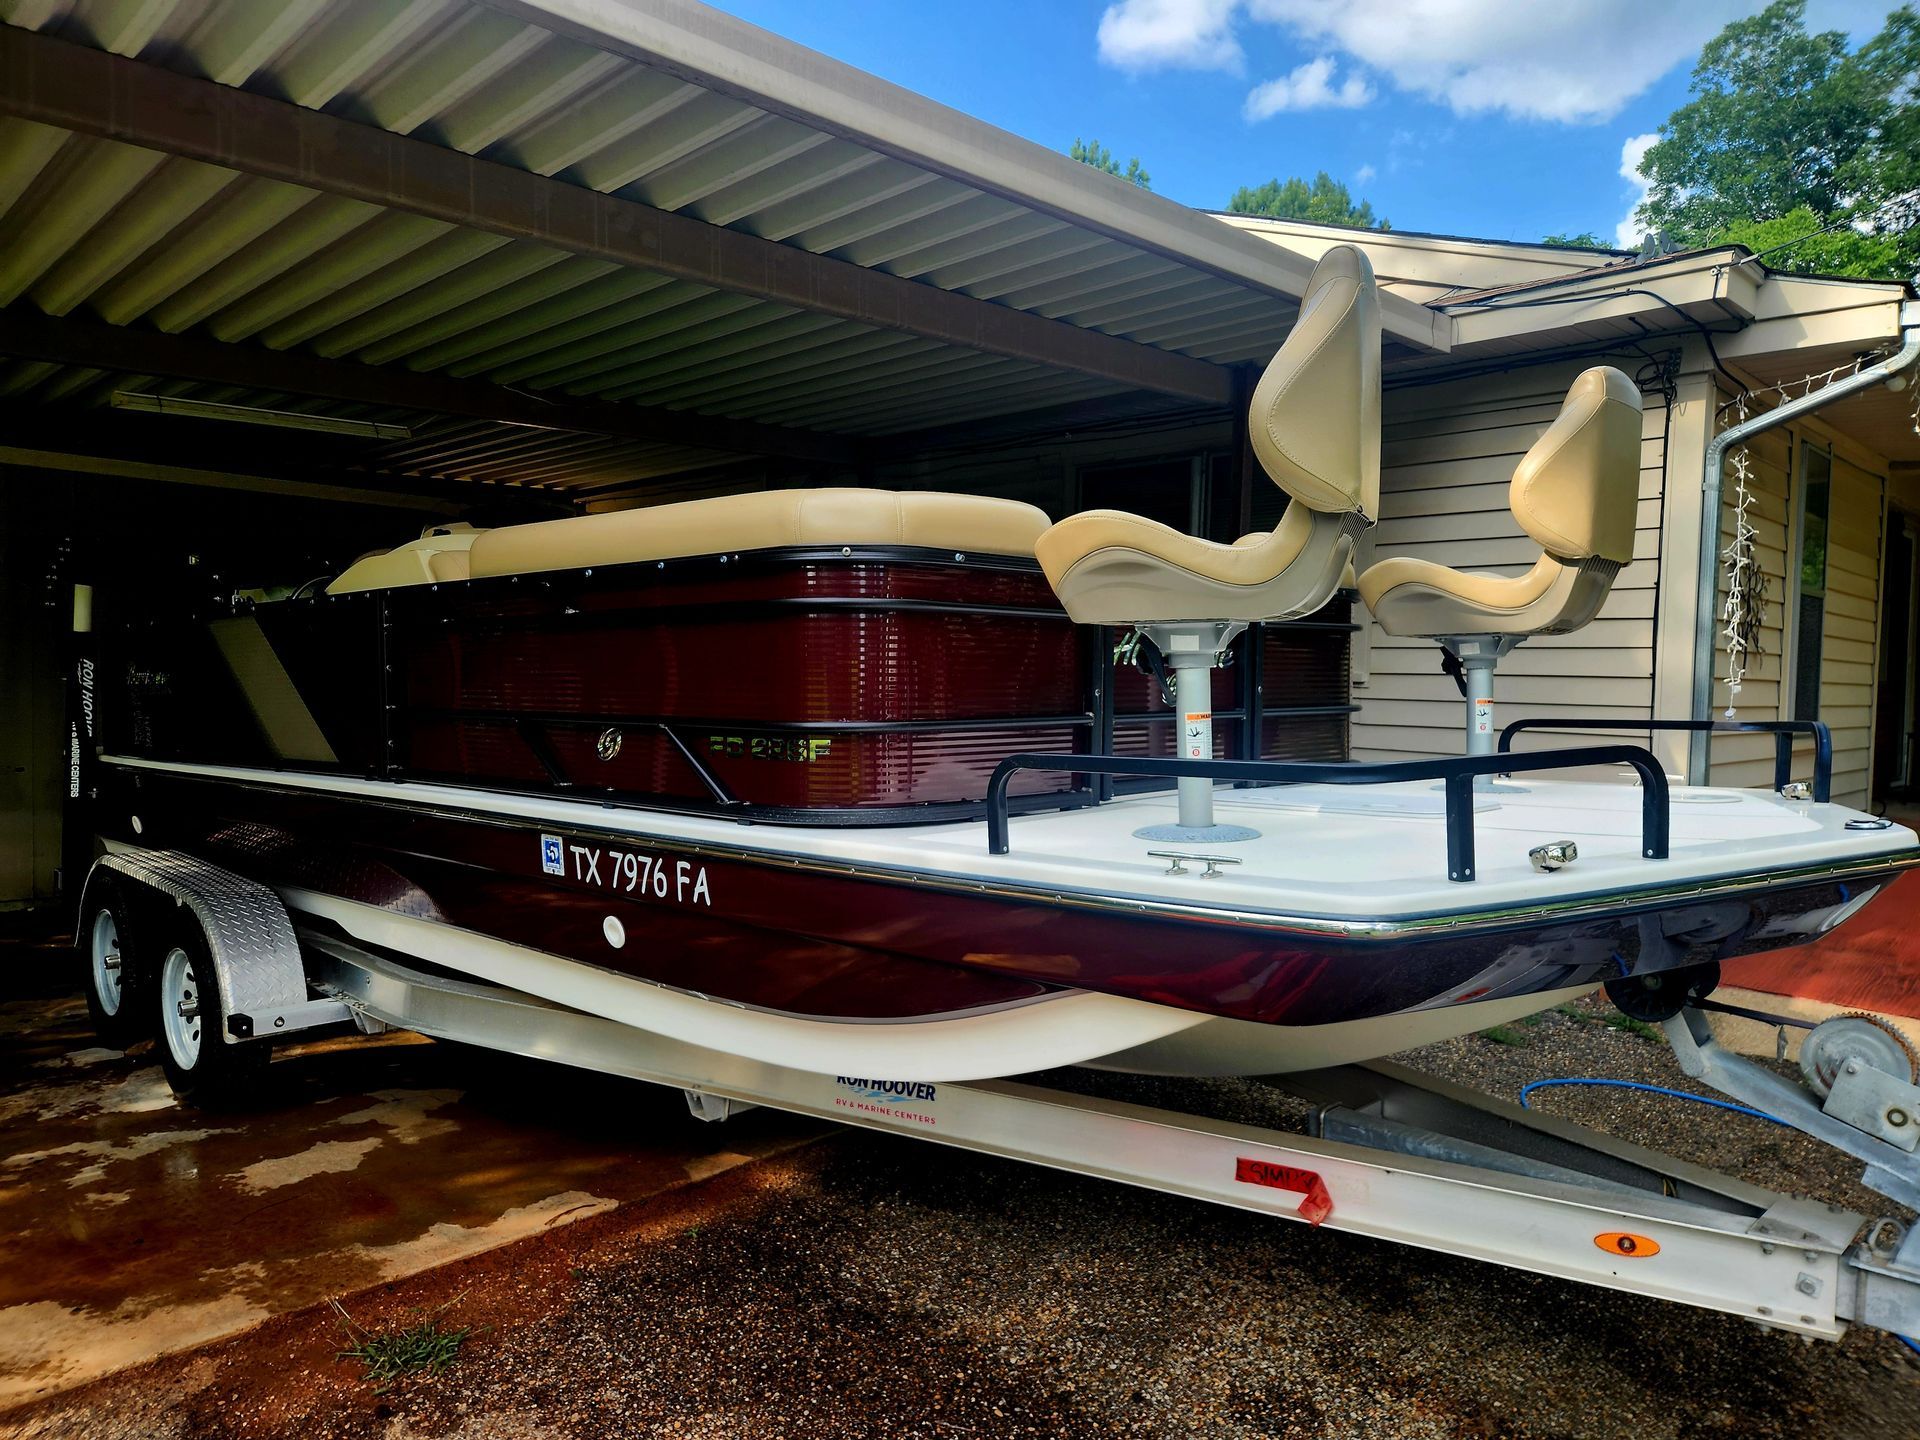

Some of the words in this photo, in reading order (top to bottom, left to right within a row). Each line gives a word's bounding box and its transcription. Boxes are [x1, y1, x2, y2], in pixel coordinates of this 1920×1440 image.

[82, 659, 94, 689] RON
[71, 738, 80, 765] MARINE
[70, 765, 79, 798] CENTERS
[570, 845, 603, 886] TX
[609, 851, 668, 898] 7976
[677, 861, 711, 907] FA
[870, 1079, 936, 1101] HOOVER
[836, 1098, 847, 1107] RV
[857, 1103, 891, 1115] MARINE
[894, 1110, 936, 1125] CENTERS
